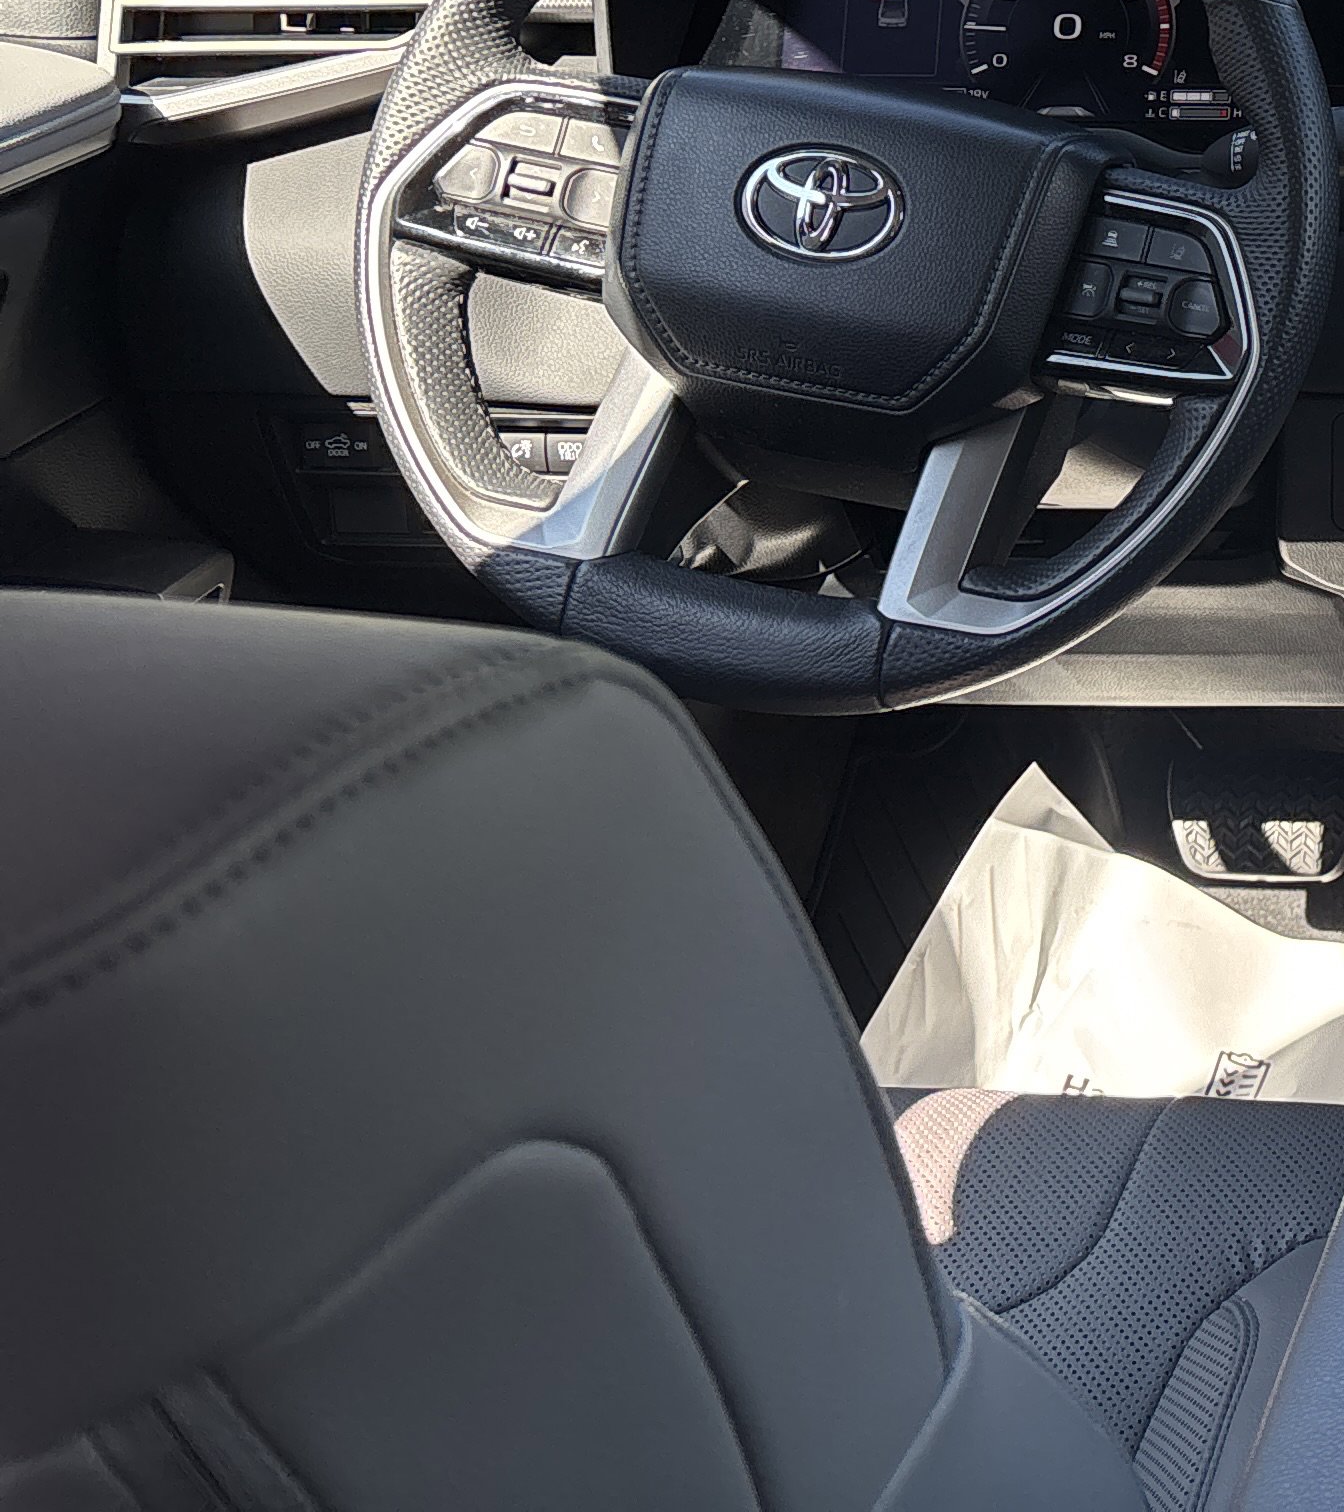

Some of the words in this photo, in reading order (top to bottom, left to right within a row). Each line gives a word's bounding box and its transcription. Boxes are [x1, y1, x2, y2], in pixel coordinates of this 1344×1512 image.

[1053, 13, 1083, 40] 0
[991, 53, 1008, 68] 0
[1122, 54, 1138, 68] 8
[1232, 107, 1243, 118] H
[1062, 331, 1093, 346] MODE
[775, 354, 842, 379] AIRBAG
[305, 440, 321, 450] OFF
[354, 440, 368, 451] ON
